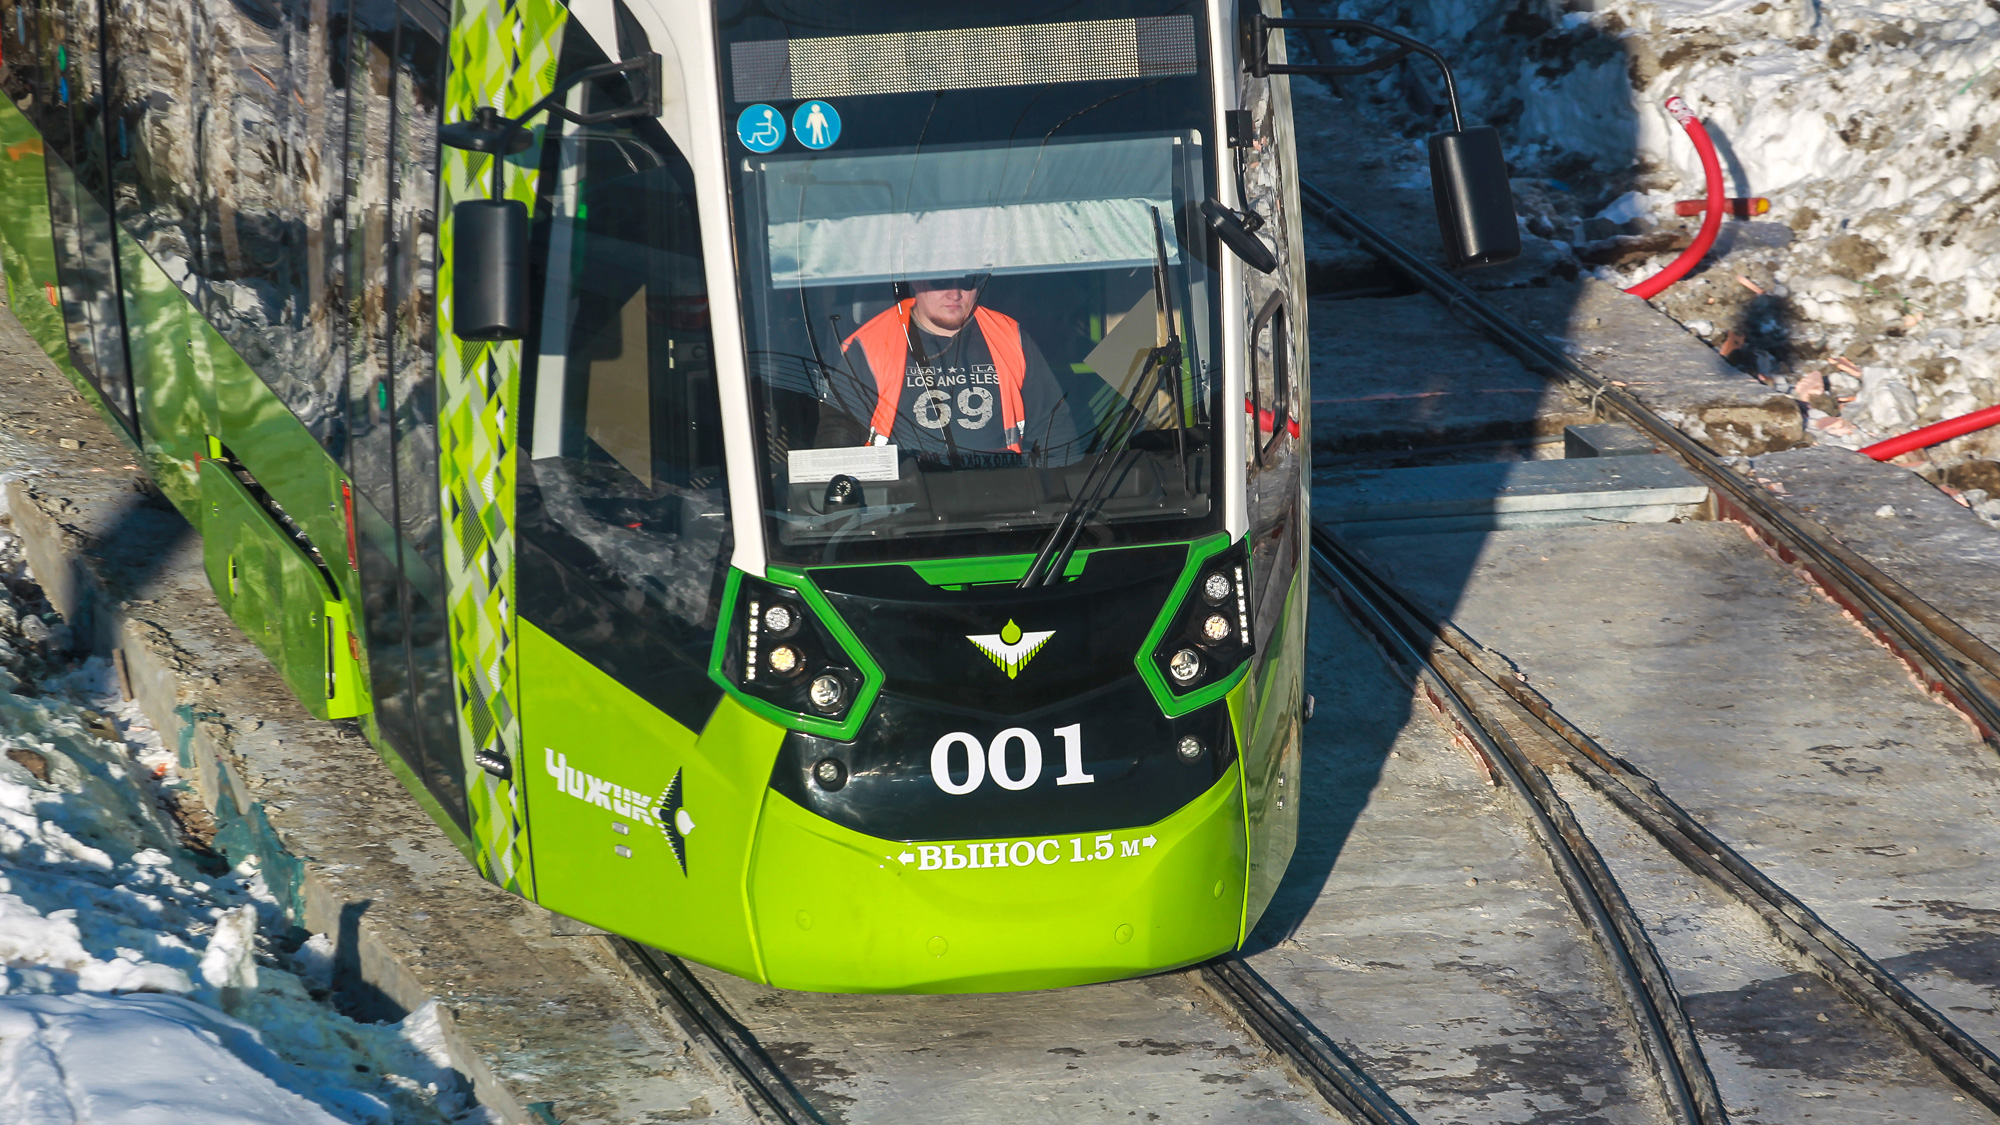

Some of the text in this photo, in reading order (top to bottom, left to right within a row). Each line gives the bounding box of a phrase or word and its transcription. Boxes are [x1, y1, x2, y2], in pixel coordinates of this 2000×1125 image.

[907, 376, 934, 387] LOS
[912, 387, 994, 430] 69
[930, 723, 1095, 795] 001
[917, 839, 1061, 871] ВЫНОС
[1069, 833, 1115, 863] 1.5
